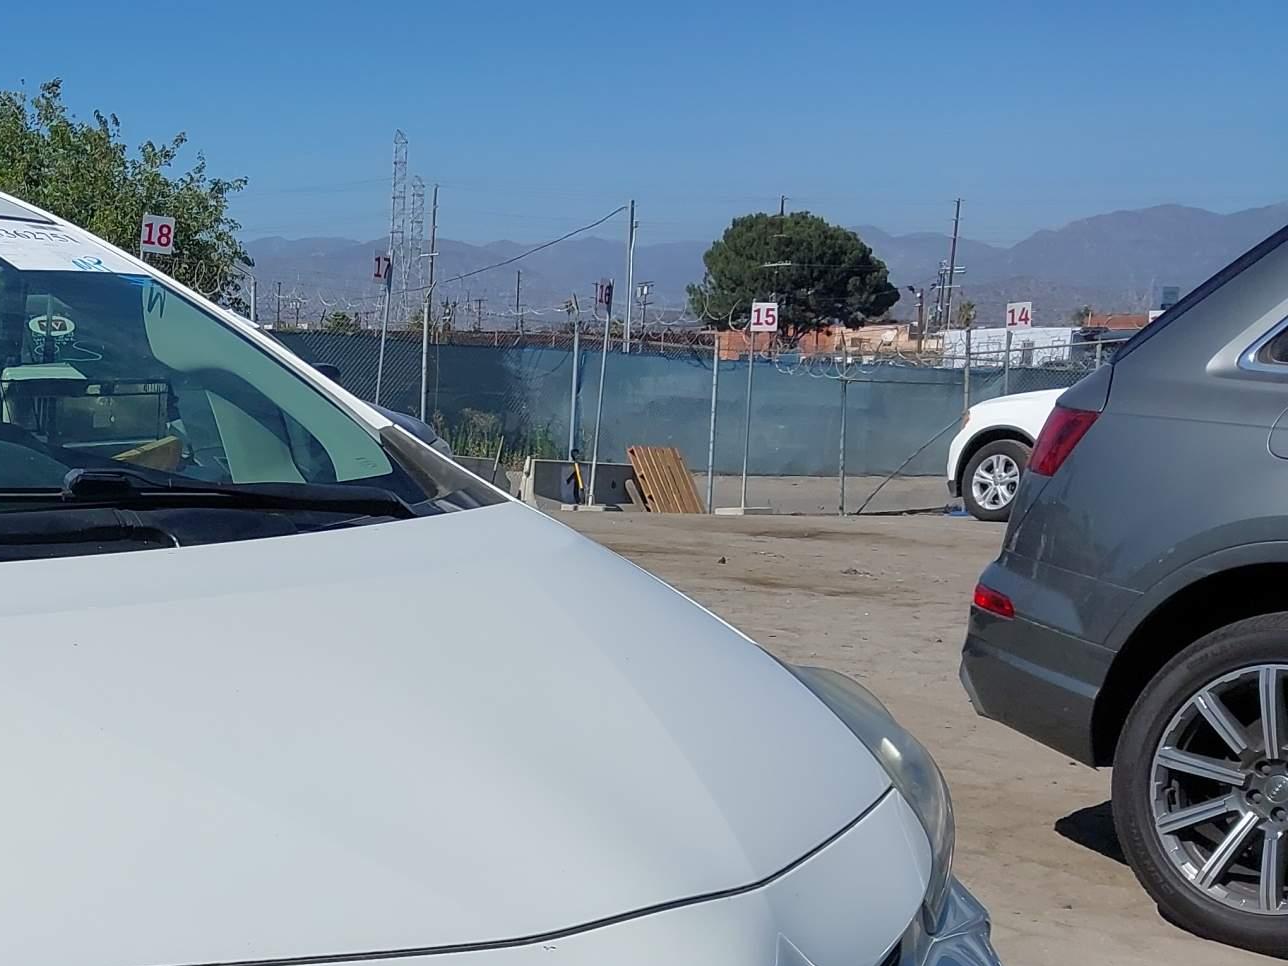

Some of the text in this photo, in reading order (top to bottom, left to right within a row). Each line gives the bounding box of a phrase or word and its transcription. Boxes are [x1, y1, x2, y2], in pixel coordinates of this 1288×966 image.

[143, 222, 172, 248] 18
[374, 256, 391, 279] 17
[752, 307, 777, 326] 15
[1007, 306, 1030, 326] 14
